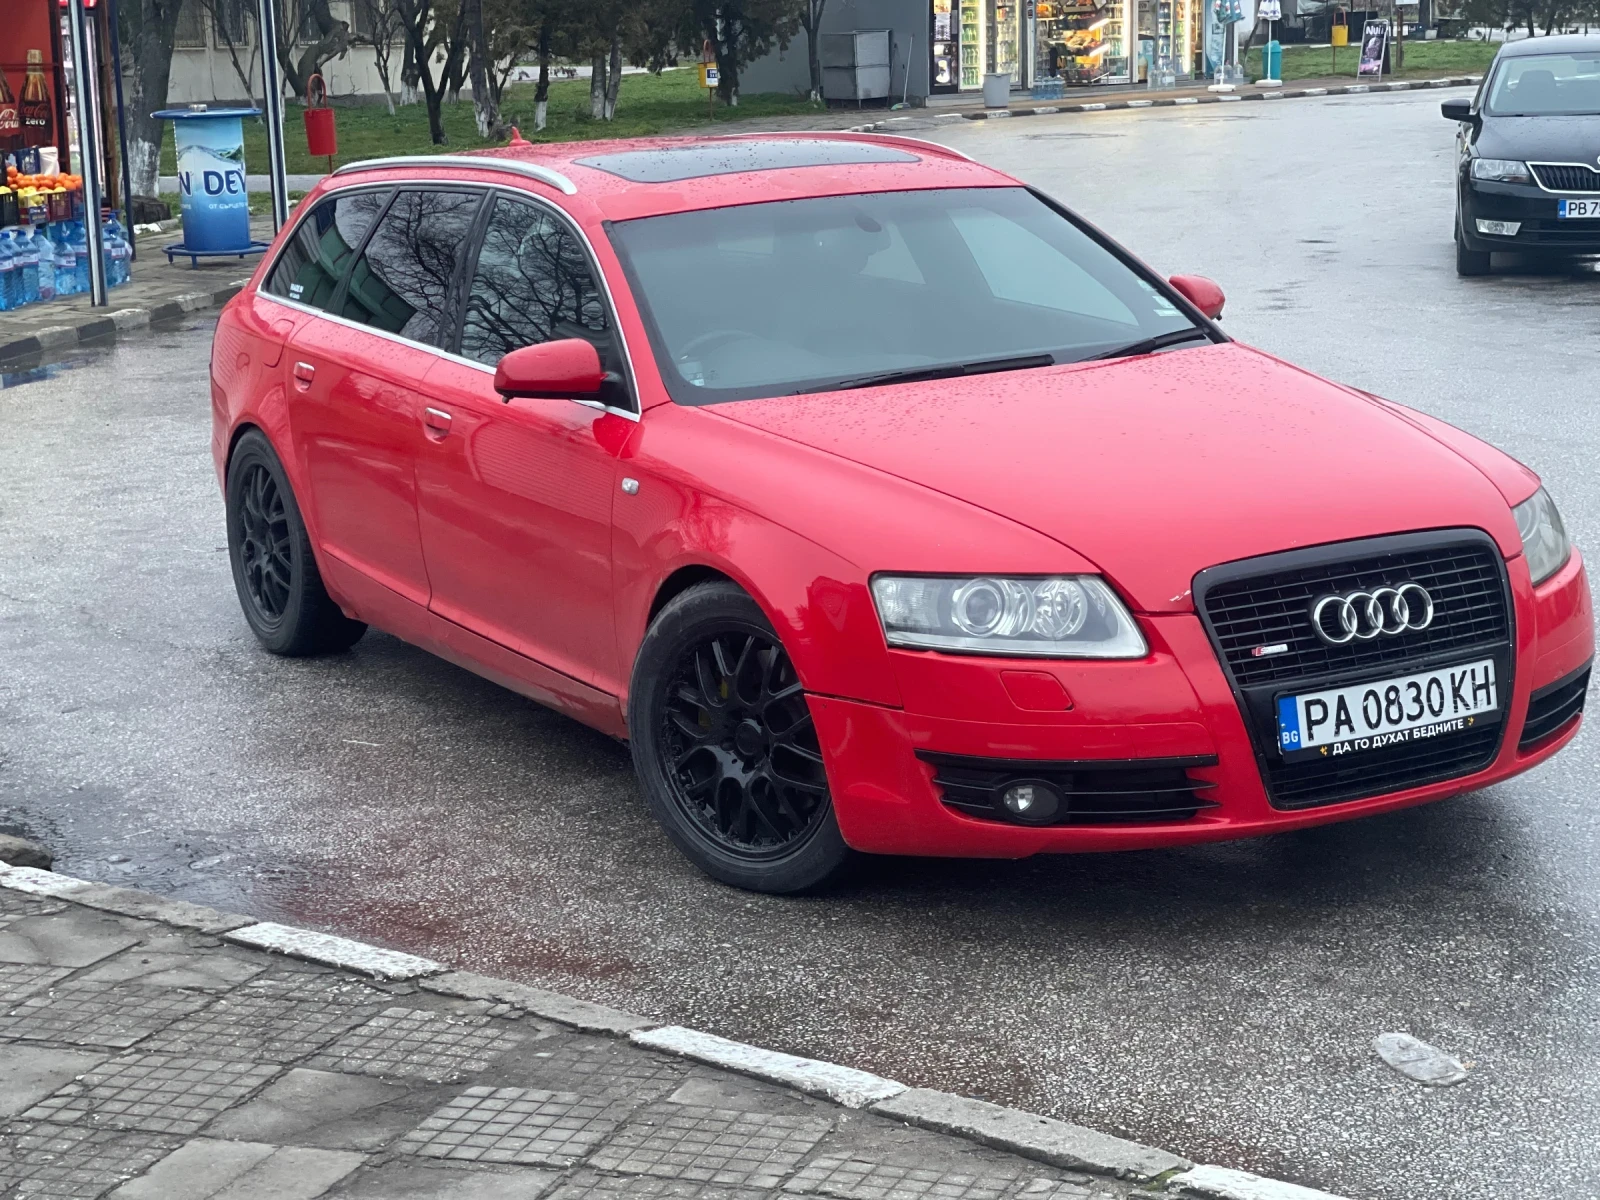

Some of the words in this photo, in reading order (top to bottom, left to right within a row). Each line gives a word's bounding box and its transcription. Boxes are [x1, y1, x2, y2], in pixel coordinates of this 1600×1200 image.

[26, 118, 46, 126] zero
[1568, 202, 1587, 215] PB
[1282, 731, 1299, 745] BG
[1332, 742, 1352, 756] ДА
[1354, 738, 1370, 751] ГО
[1372, 730, 1411, 749] ДУХАТ
[1413, 718, 1465, 739] БЕДНИТЕ
